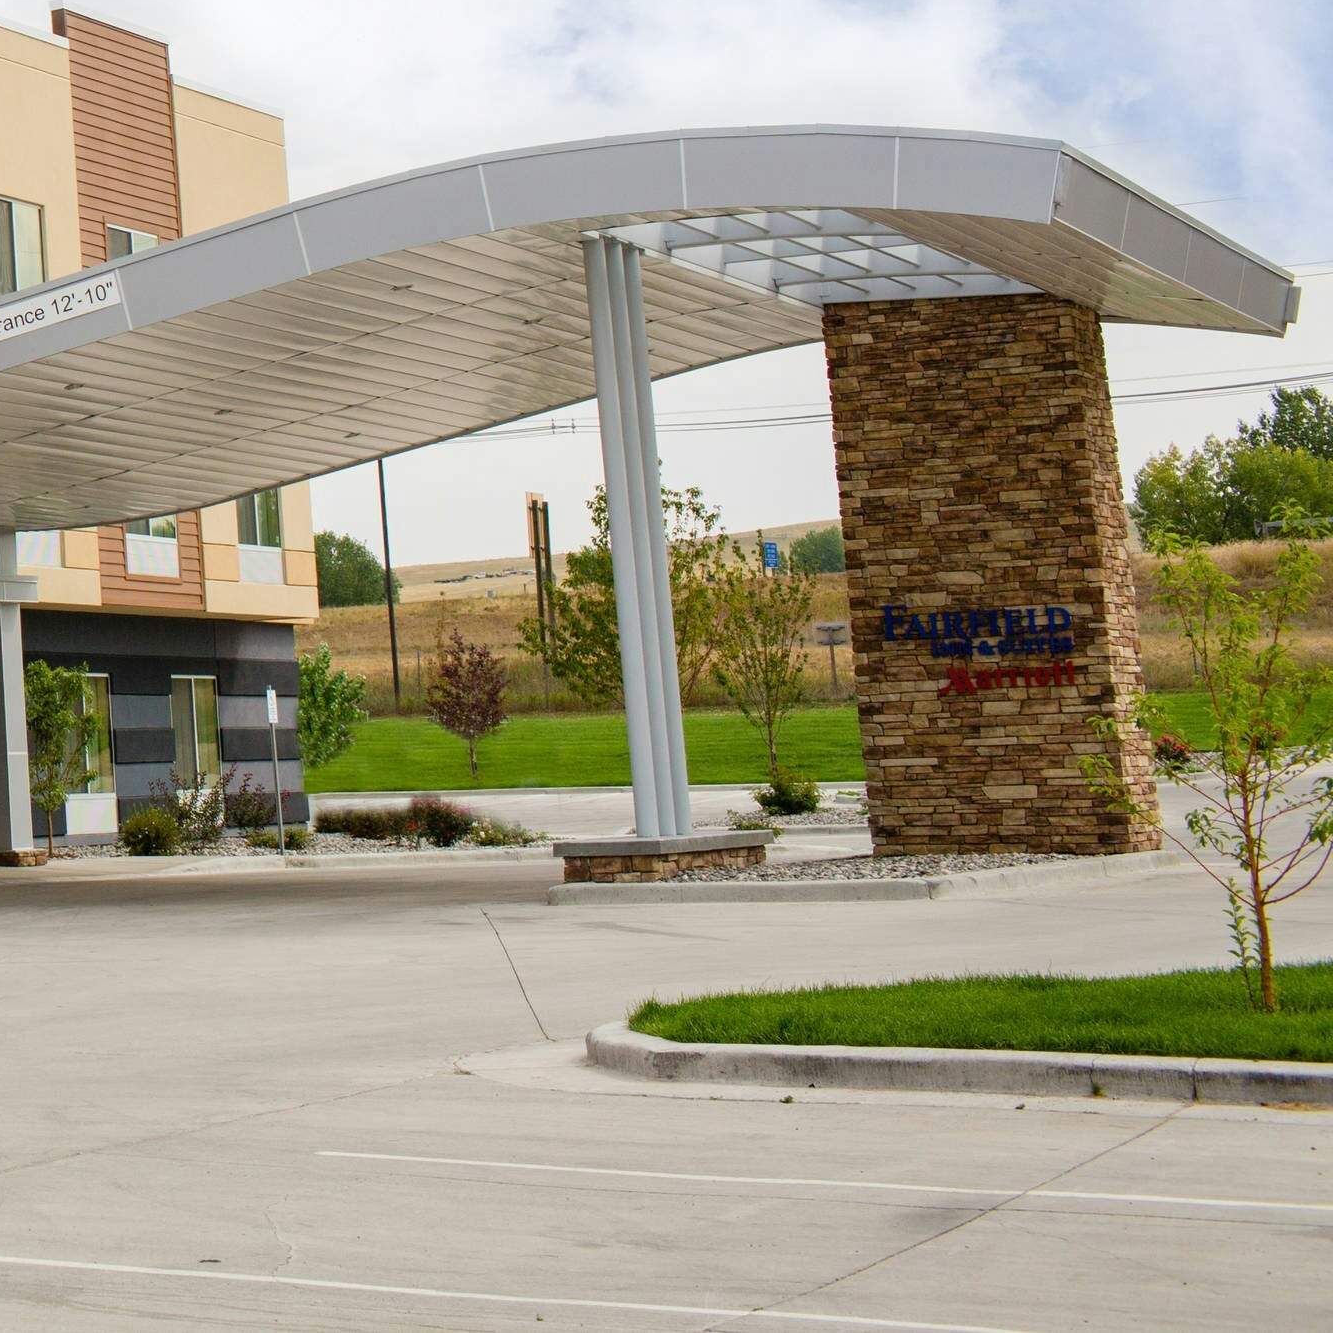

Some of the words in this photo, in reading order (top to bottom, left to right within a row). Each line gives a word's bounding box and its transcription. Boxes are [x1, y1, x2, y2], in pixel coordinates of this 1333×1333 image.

[882, 604, 1073, 642] FAIRFIELD
[933, 639, 973, 658] INN
[997, 636, 1075, 655] SUITES
[939, 660, 1076, 696] Marriott
